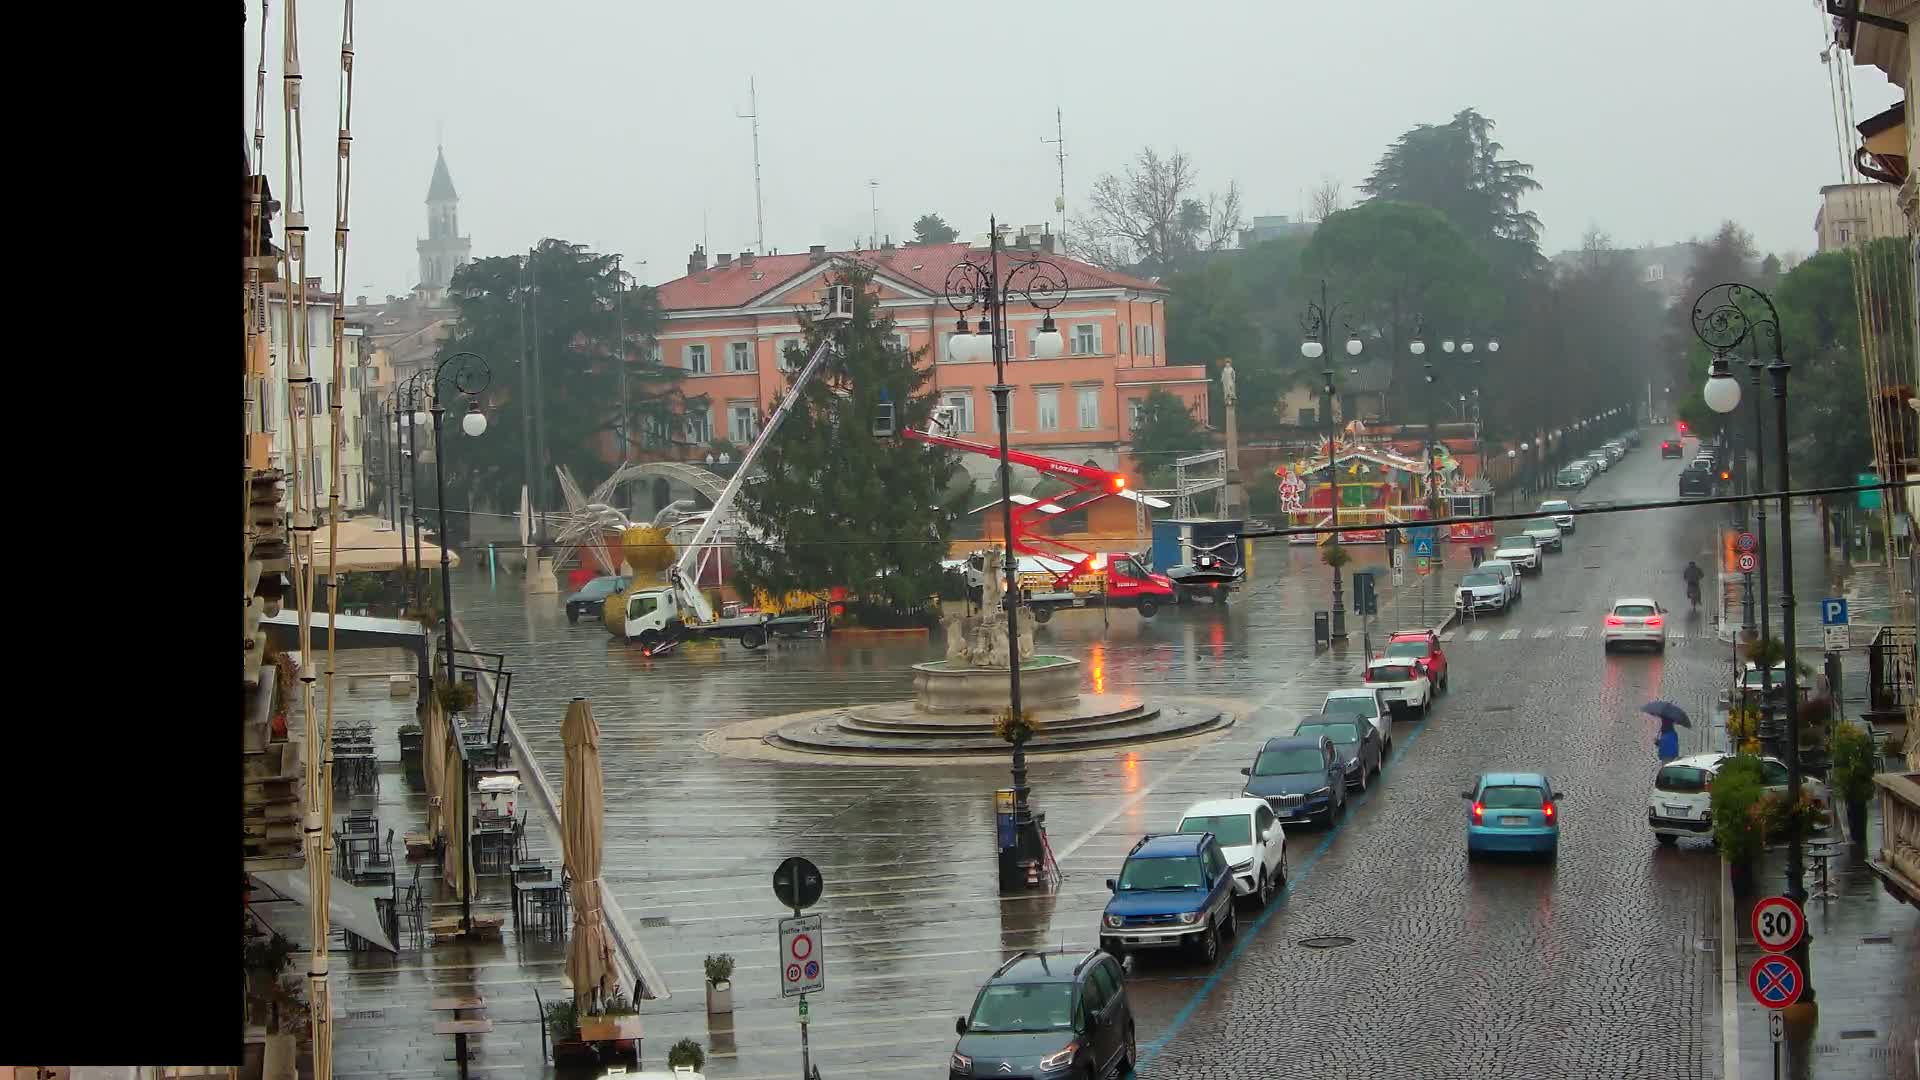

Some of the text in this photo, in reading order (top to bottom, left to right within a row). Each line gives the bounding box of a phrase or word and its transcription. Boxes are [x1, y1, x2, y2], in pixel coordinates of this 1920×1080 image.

[1742, 557, 1753, 567] 20
[1827, 602, 1841, 621] P
[1763, 911, 1791, 938] 30
